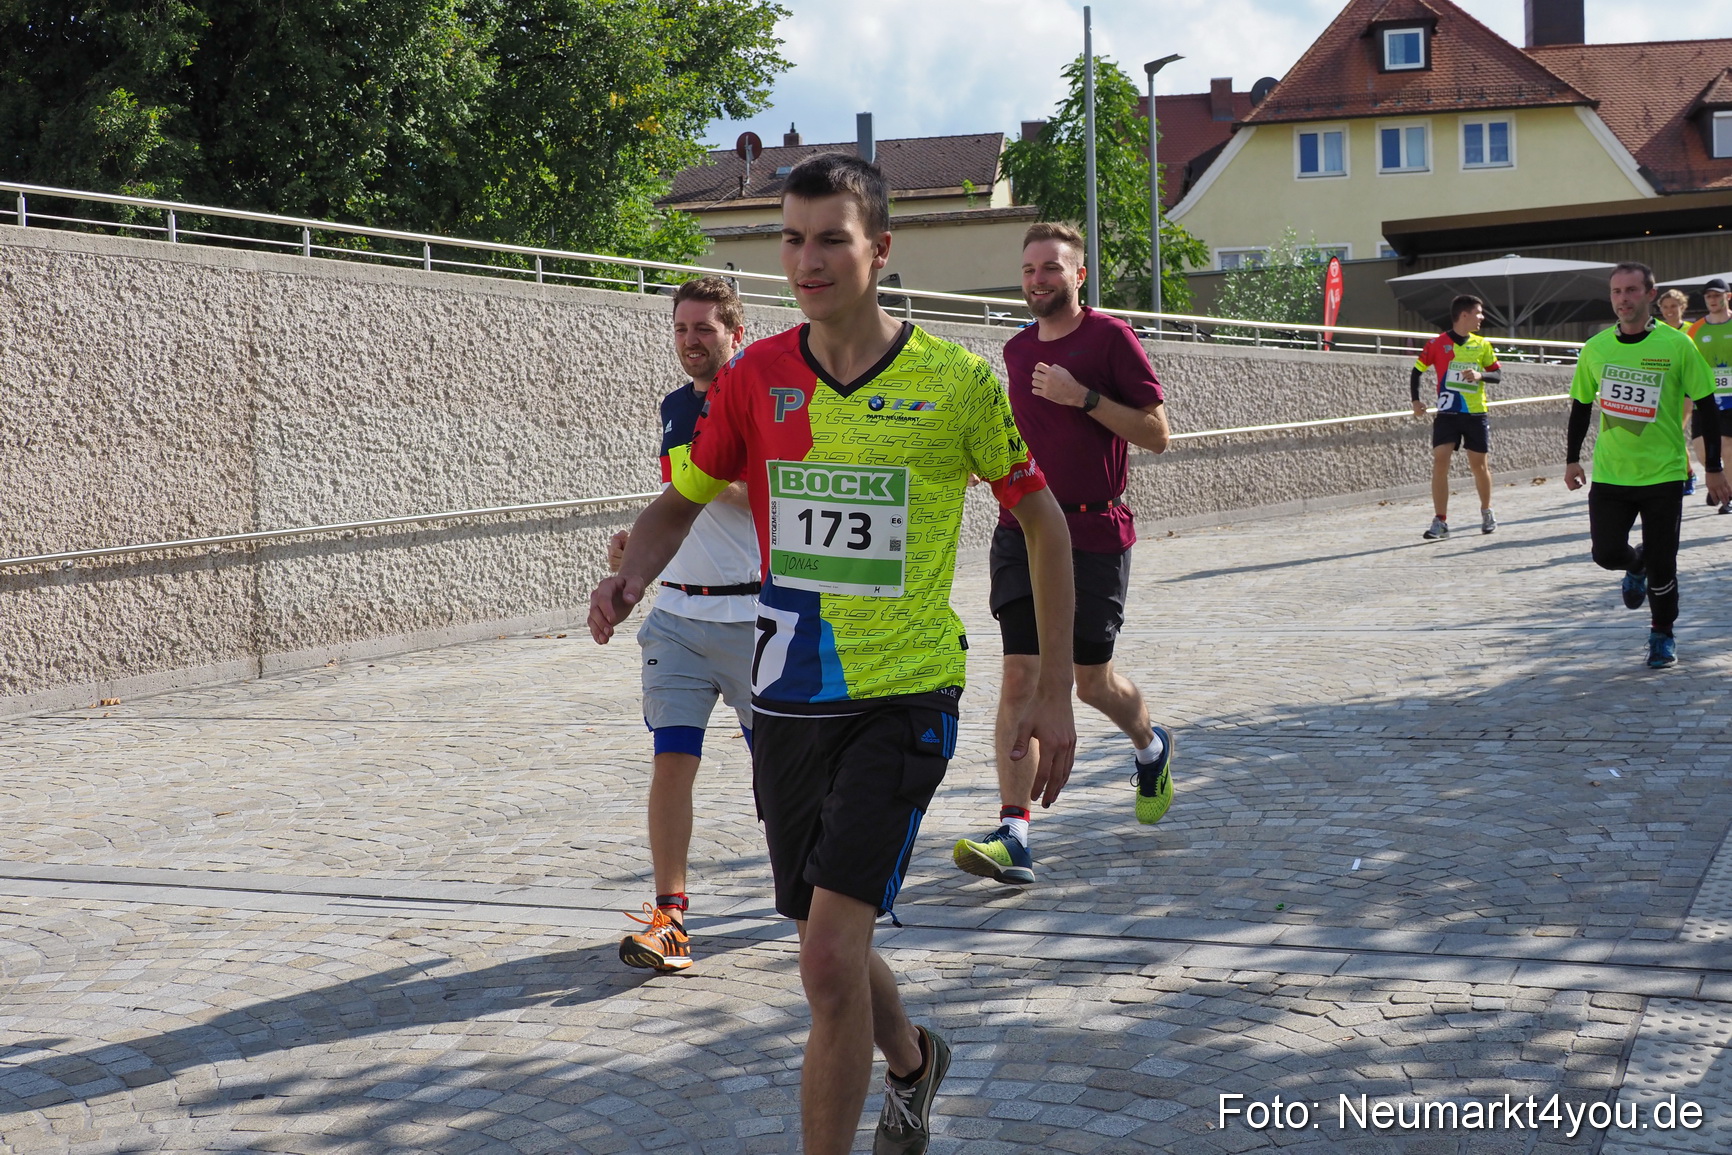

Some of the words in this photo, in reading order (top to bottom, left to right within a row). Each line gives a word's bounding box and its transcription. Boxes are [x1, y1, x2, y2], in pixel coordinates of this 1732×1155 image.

[1606, 367, 1657, 386] BOCK
[1610, 384, 1646, 403] 533
[1603, 401, 1651, 414] KANSTANTSIN
[778, 466, 894, 501] BOCK
[797, 508, 872, 551] 173
[891, 517, 902, 525] E6
[781, 555, 820, 575] JONAS
